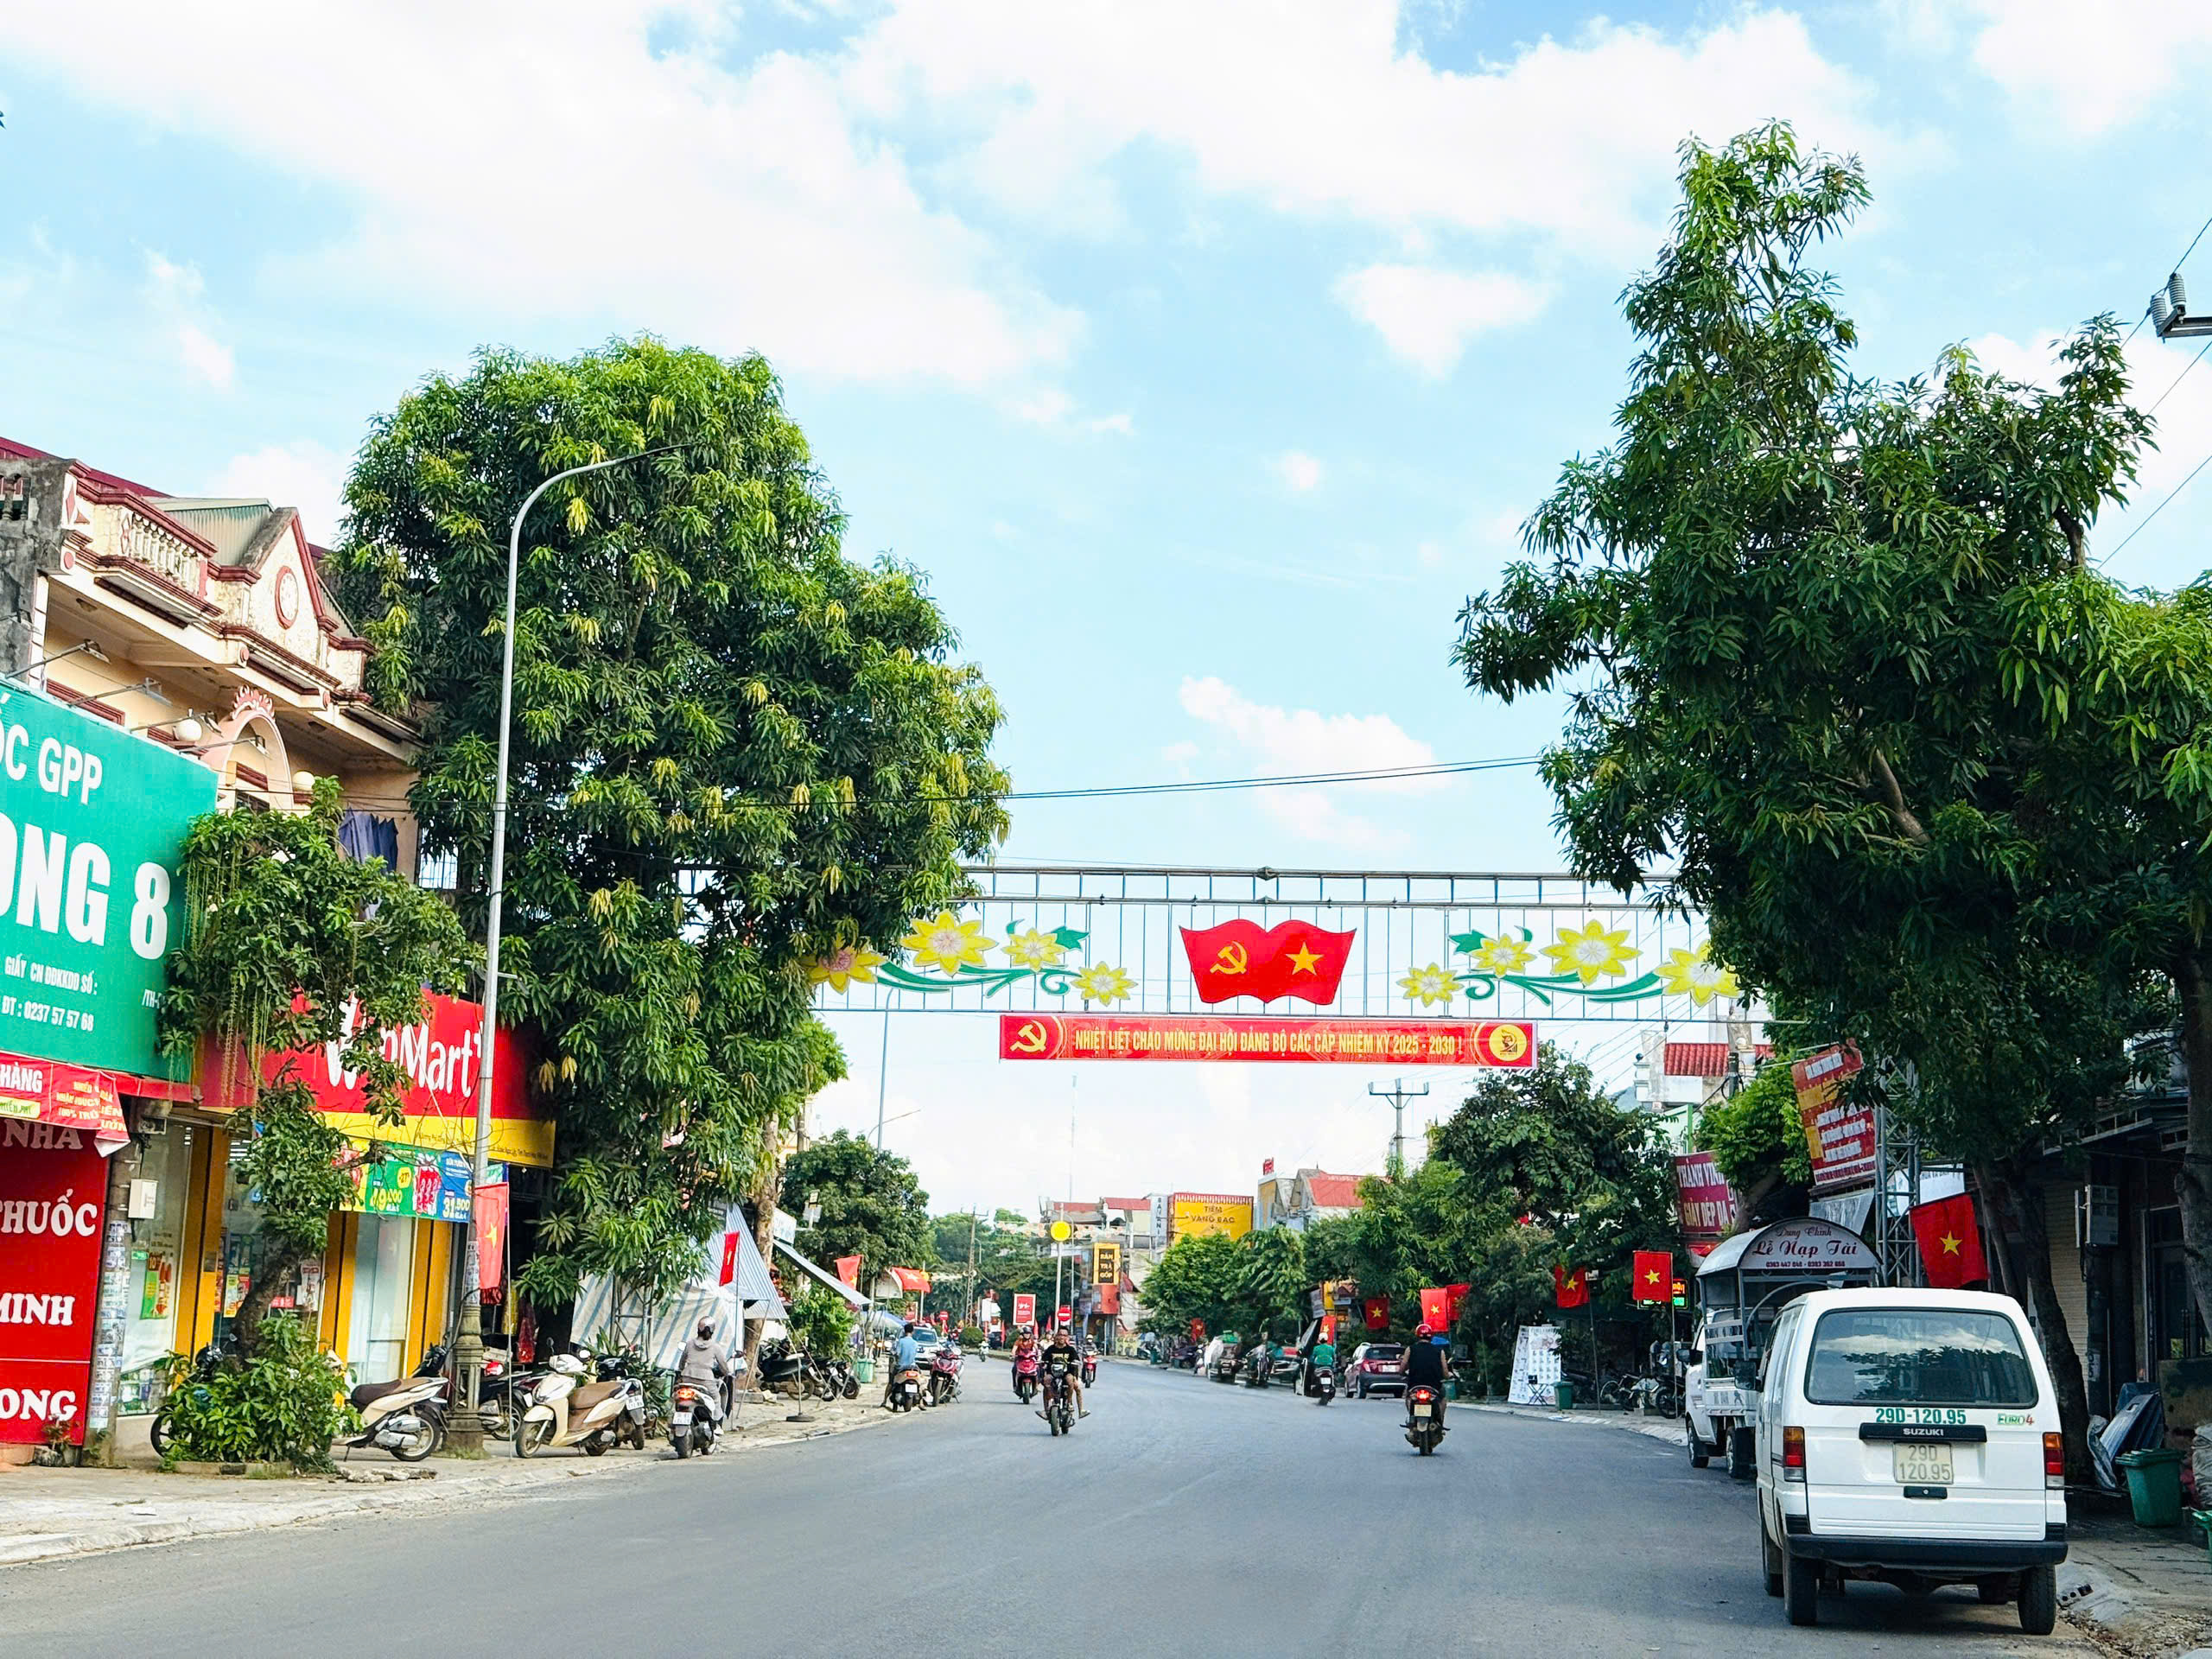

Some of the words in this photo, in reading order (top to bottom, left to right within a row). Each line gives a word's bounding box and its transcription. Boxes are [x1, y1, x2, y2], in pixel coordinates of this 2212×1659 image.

[0, 694, 29, 781] C
[38, 737, 103, 805] GPP
[130, 861, 170, 960] 8
[30, 962, 43, 983] CN
[2, 995, 16, 1016] ĐT
[23, 1001, 50, 1023] 0237
[51, 1007, 66, 1027] 57
[66, 1009, 80, 1029] 57
[80, 1013, 94, 1032] 68
[1076, 1025, 1105, 1055] NHIỆT
[1109, 1026, 1131, 1056] LIỆT
[1133, 1026, 1161, 1051] CHÀO
[1166, 1027, 1196, 1052] MỪNG
[1219, 1027, 1237, 1057] HỘI
[1273, 1028, 1287, 1057] BỘ
[1290, 1029, 1311, 1052] CÁC
[1338, 1030, 1374, 1059] NHIỆM
[1376, 1030, 1390, 1055] KỲ
[1393, 1034, 1419, 1055] 2025
[1429, 1036, 1455, 1056] 2030
[0, 1062, 43, 1093] HÀNG
[1779, 1241, 1819, 1258] Nạp
[1876, 1408, 1967, 1425] 29D-120.95
[1903, 1427, 1944, 1436] SUZUKI
[1908, 1445, 1938, 1462] 29D
[1899, 1463, 1952, 1480] 120.95
